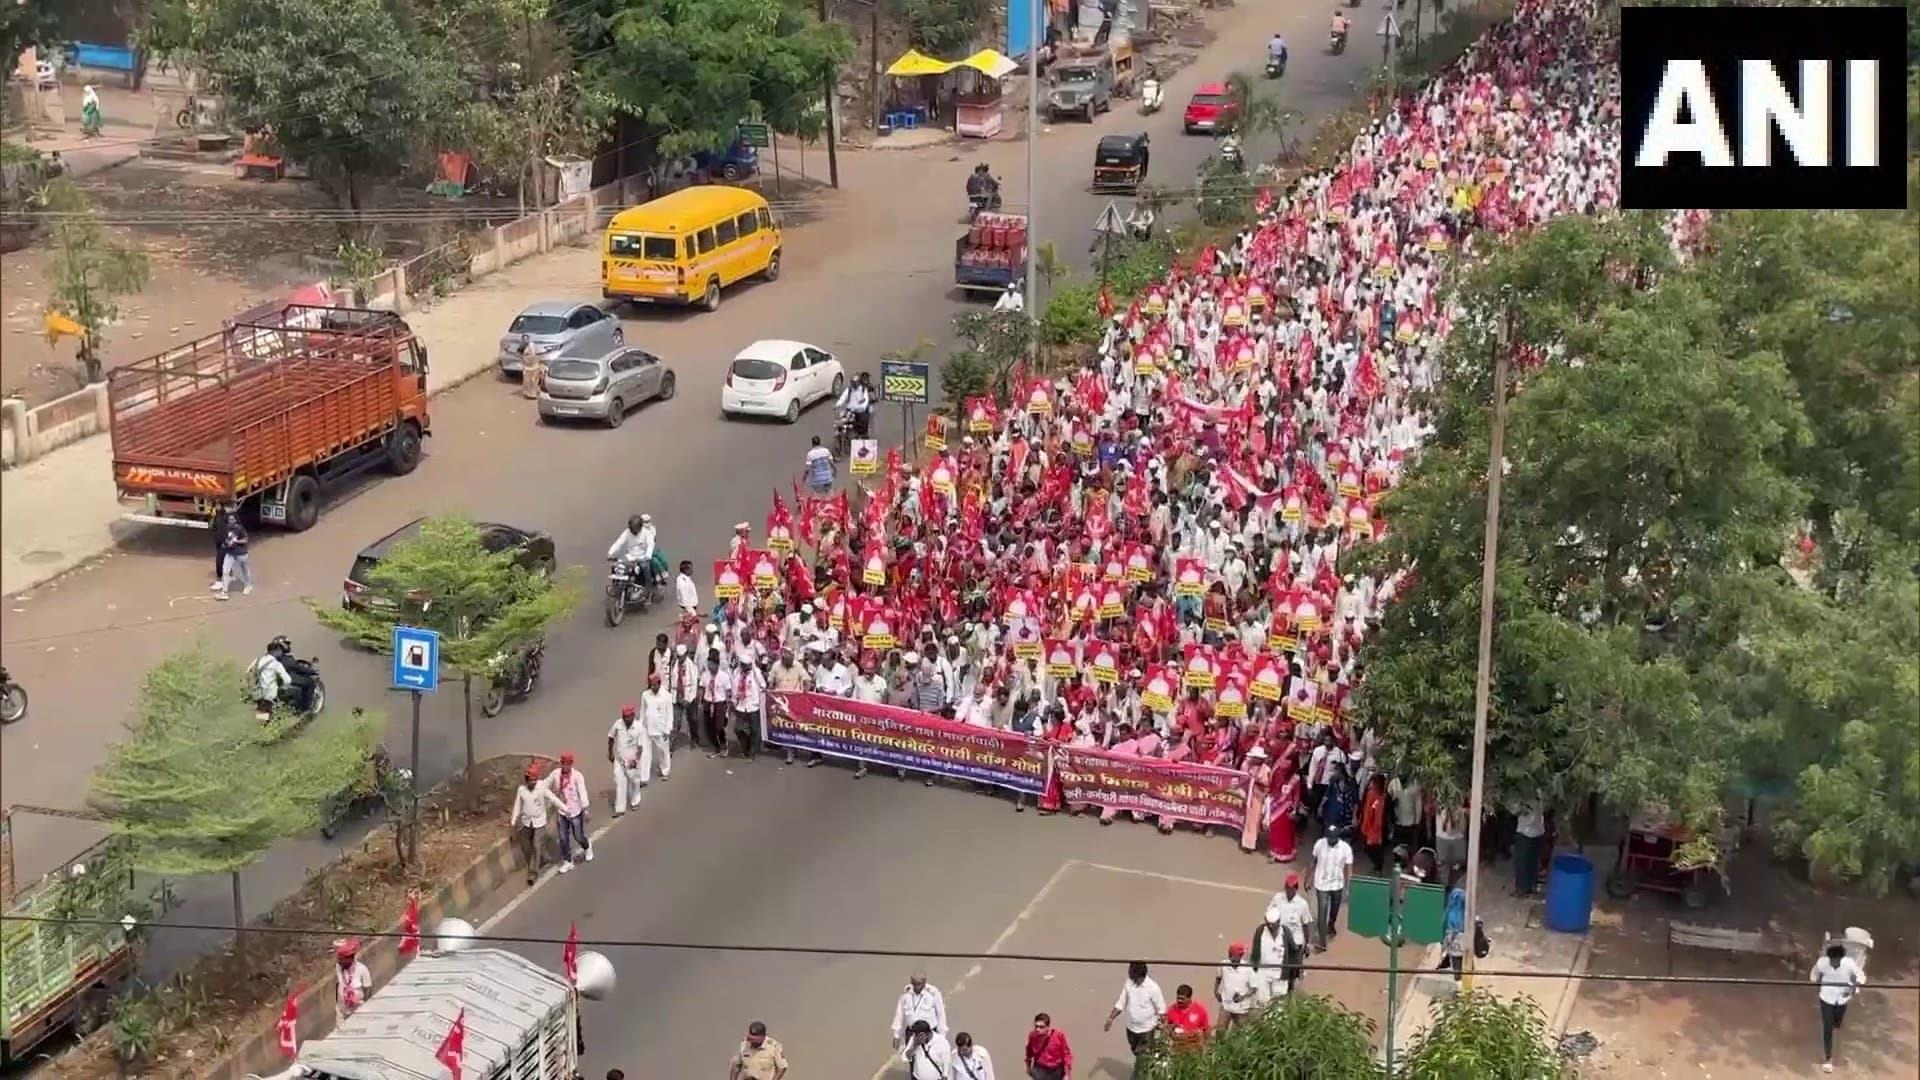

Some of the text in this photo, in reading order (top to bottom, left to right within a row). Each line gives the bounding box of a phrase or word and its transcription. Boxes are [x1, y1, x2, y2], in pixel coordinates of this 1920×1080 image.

[128, 467, 217, 482] ASHOK LEYLAND
[812, 706, 857, 724] भारताचा
